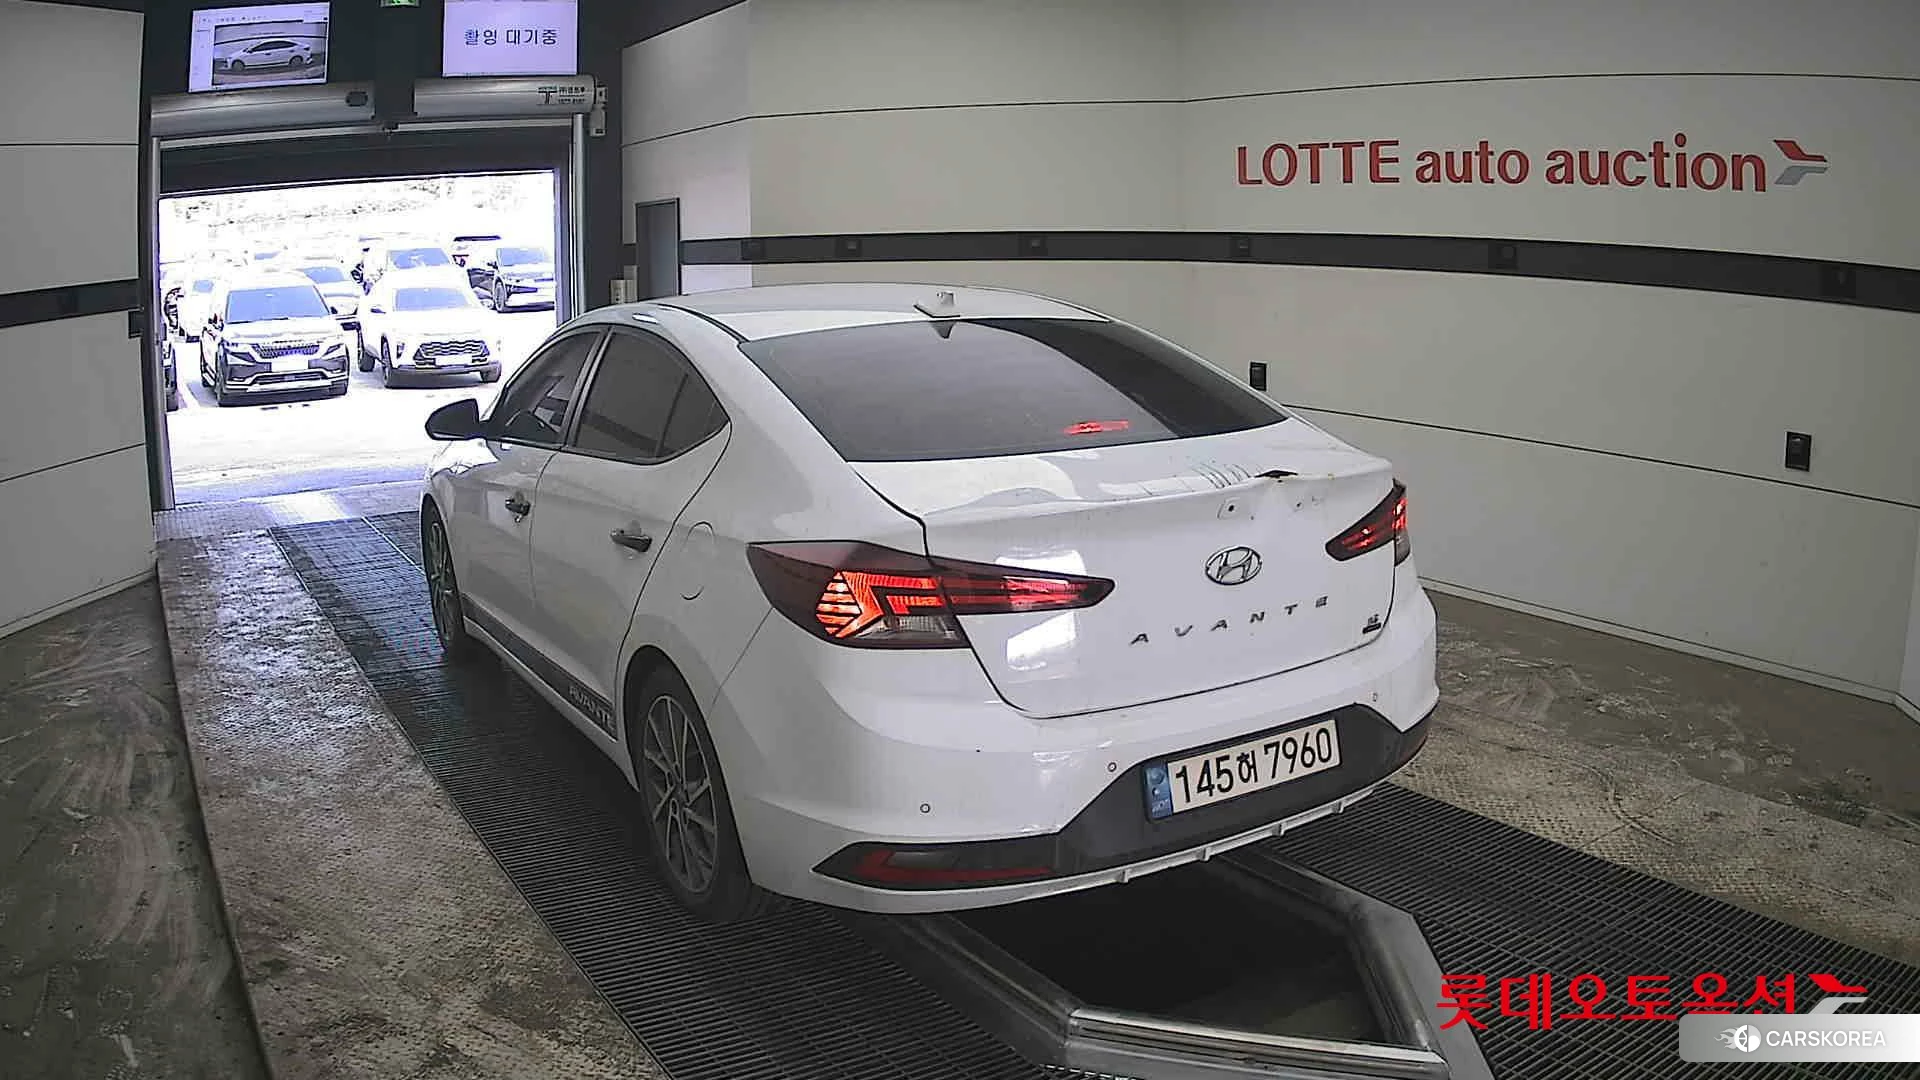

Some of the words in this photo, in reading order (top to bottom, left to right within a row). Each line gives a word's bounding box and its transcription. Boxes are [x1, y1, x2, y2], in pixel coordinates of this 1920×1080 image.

[506, 29, 557, 46] 대기중
[1237, 139, 1400, 186] LOTTE
[1415, 140, 1530, 184] auto
[1545, 133, 1766, 193] auction
[1130, 596, 1328, 645] AVANTE
[1175, 750, 1259, 803] 145허
[1263, 728, 1332, 780] 7960
